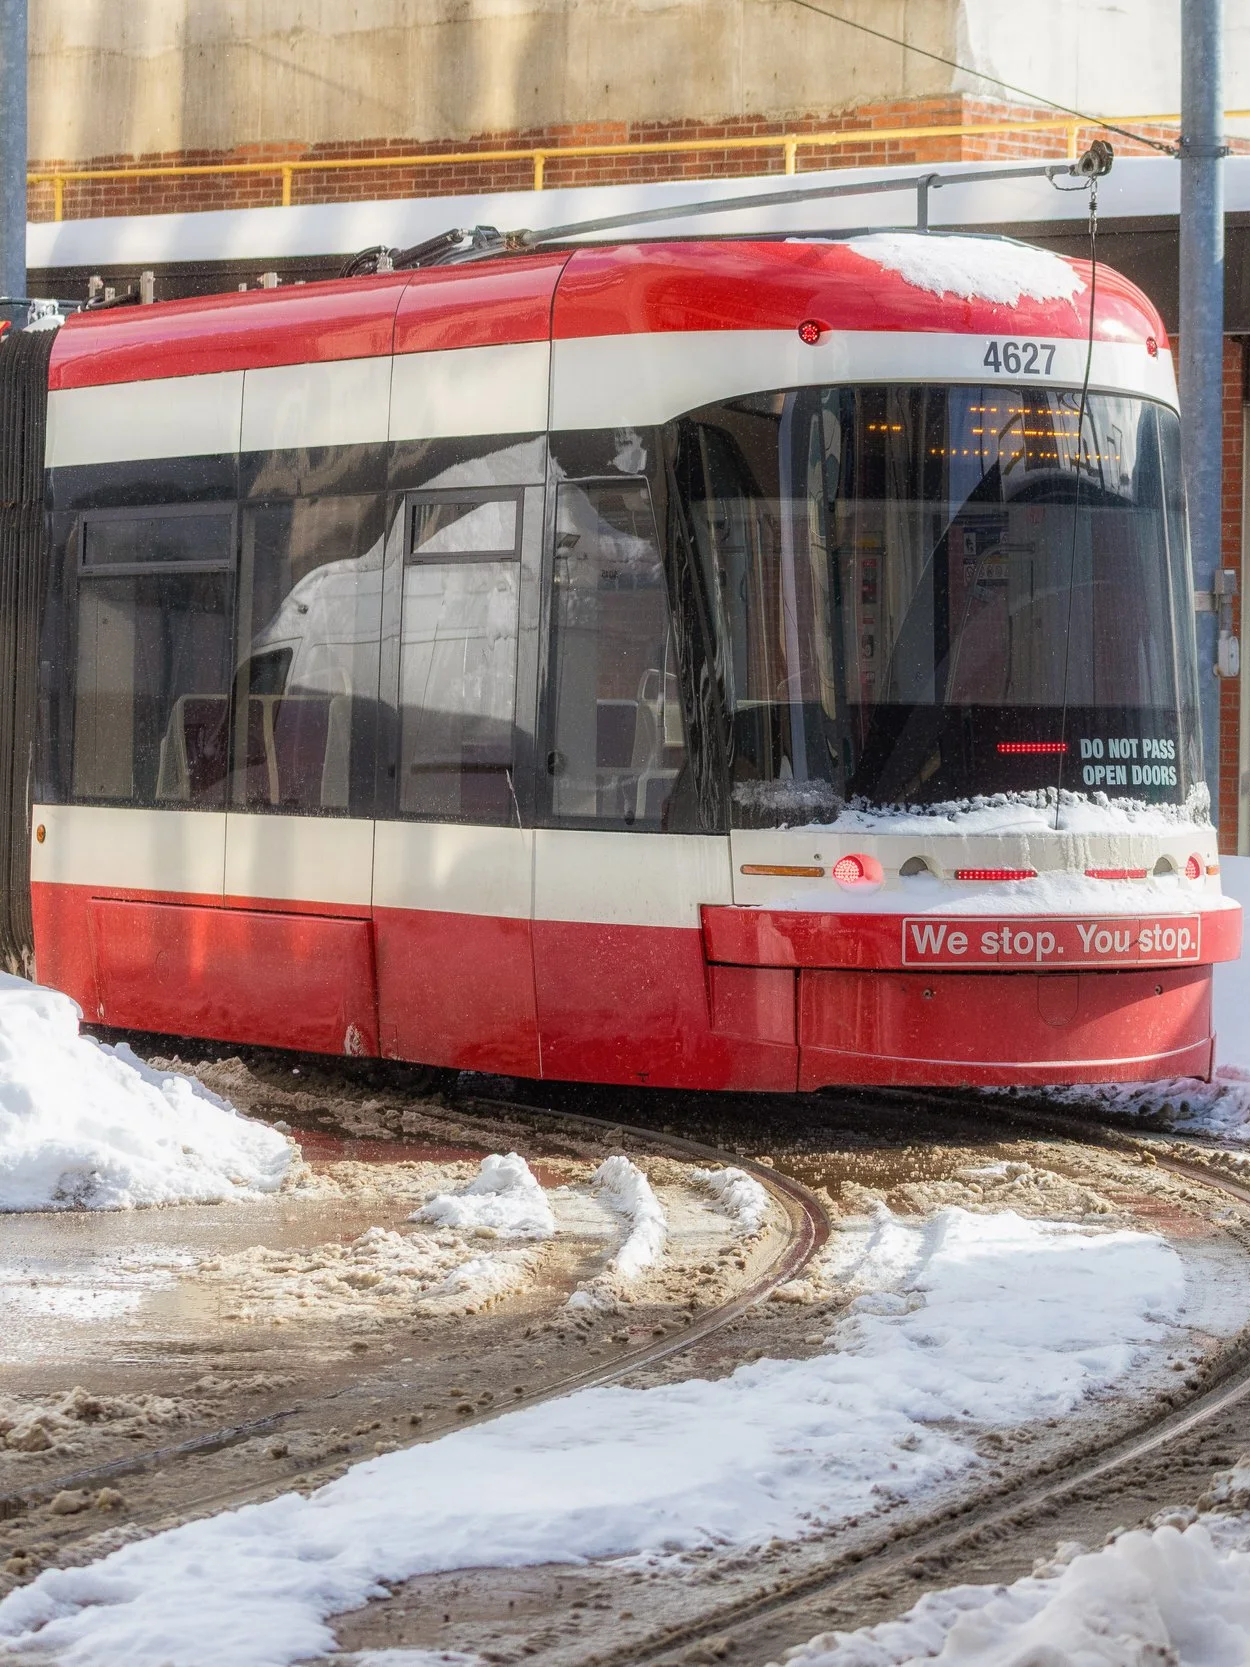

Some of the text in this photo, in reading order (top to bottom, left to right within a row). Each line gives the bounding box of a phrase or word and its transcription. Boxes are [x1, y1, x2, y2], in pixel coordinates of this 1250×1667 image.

[983, 341, 1056, 375] 4627
[1080, 738, 1176, 760] DO NOT PASS
[1082, 765, 1178, 786] OPEN DOORS
[911, 923, 1197, 962] We stop. You stop.
